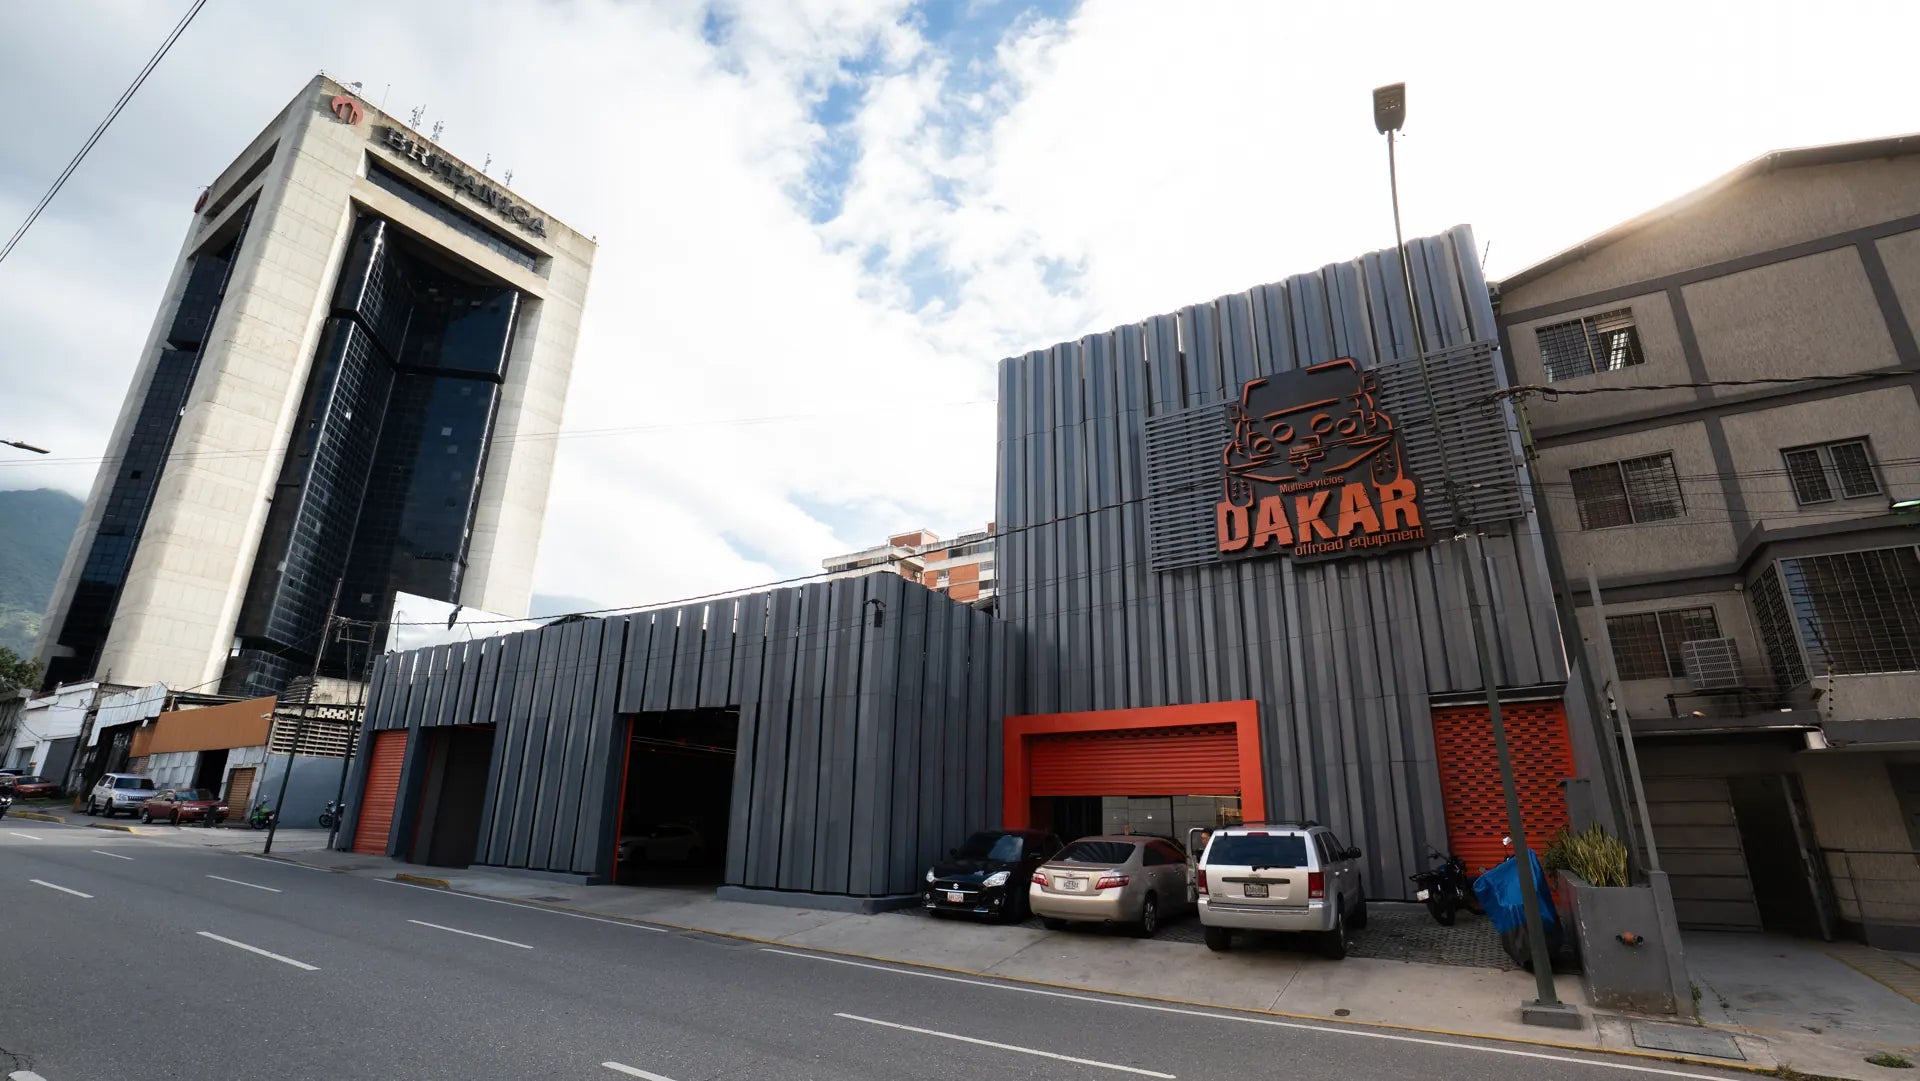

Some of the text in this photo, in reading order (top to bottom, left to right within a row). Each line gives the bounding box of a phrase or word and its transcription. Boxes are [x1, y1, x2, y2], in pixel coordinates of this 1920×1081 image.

[386, 126, 547, 238] BRITANICA
[1279, 475, 1345, 494] Multiservicios
[1216, 478, 1422, 553] DAKAR
[1294, 527, 1425, 557] offroad equipment
